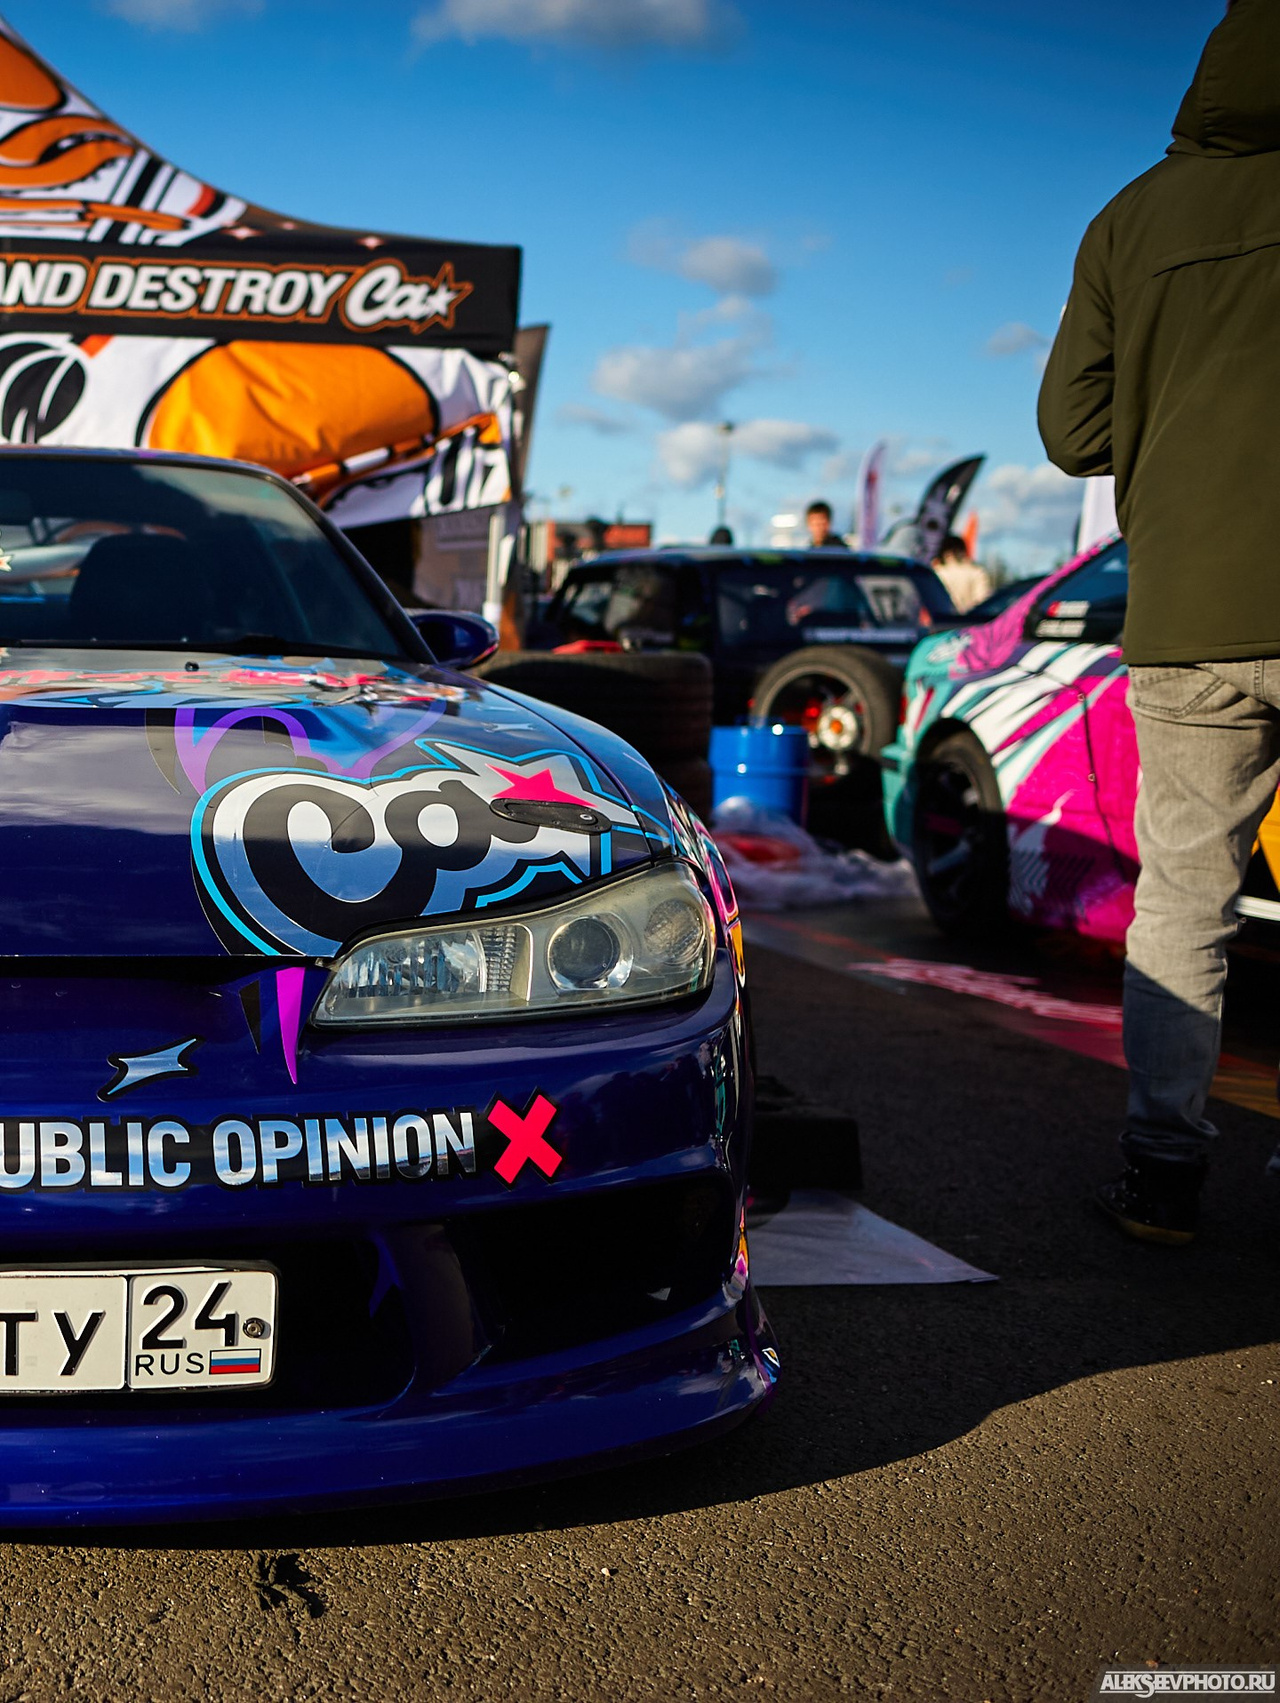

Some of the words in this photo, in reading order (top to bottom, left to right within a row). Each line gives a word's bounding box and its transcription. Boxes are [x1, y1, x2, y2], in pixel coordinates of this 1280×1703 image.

[91, 264, 350, 316] DESTROY
[213, 1111, 475, 1185] OPINION
[141, 1281, 237, 1350] 24
[134, 1353, 205, 1377] RUS
